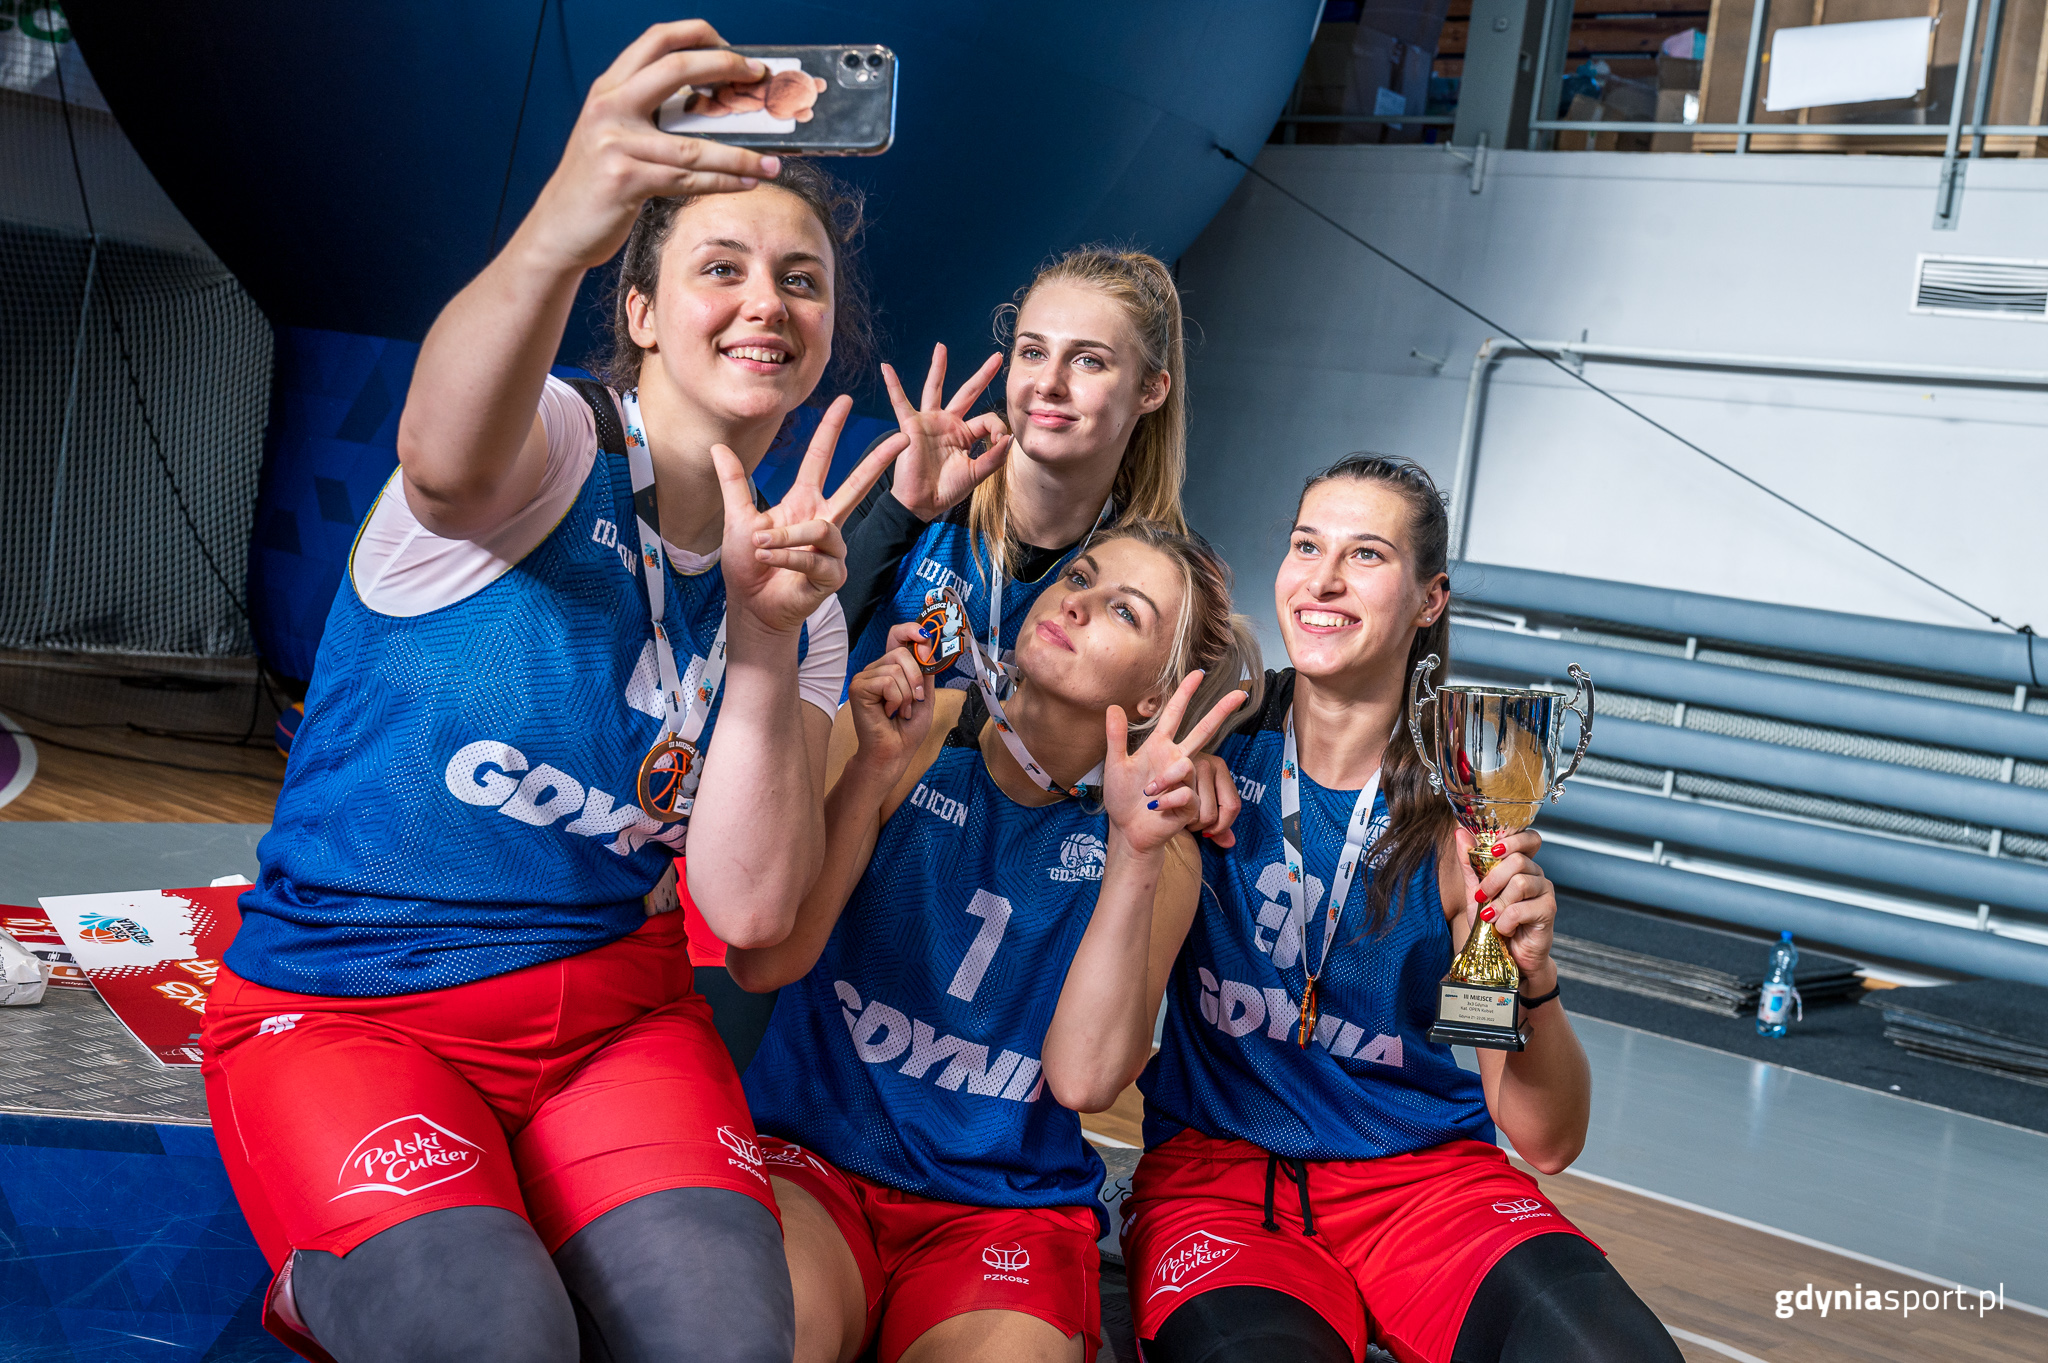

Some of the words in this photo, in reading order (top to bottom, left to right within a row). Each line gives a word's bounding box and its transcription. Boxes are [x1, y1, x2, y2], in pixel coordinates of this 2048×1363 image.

[946, 888, 1013, 1002] 1
[1470, 994, 1492, 1002] MIEJSCE
[833, 979, 1046, 1103] DYNI
[354, 1132, 442, 1178] Polski
[385, 1148, 470, 1183] Cukier
[1157, 1239, 1210, 1282] Polski
[1171, 1248, 1231, 1284] Cukier
